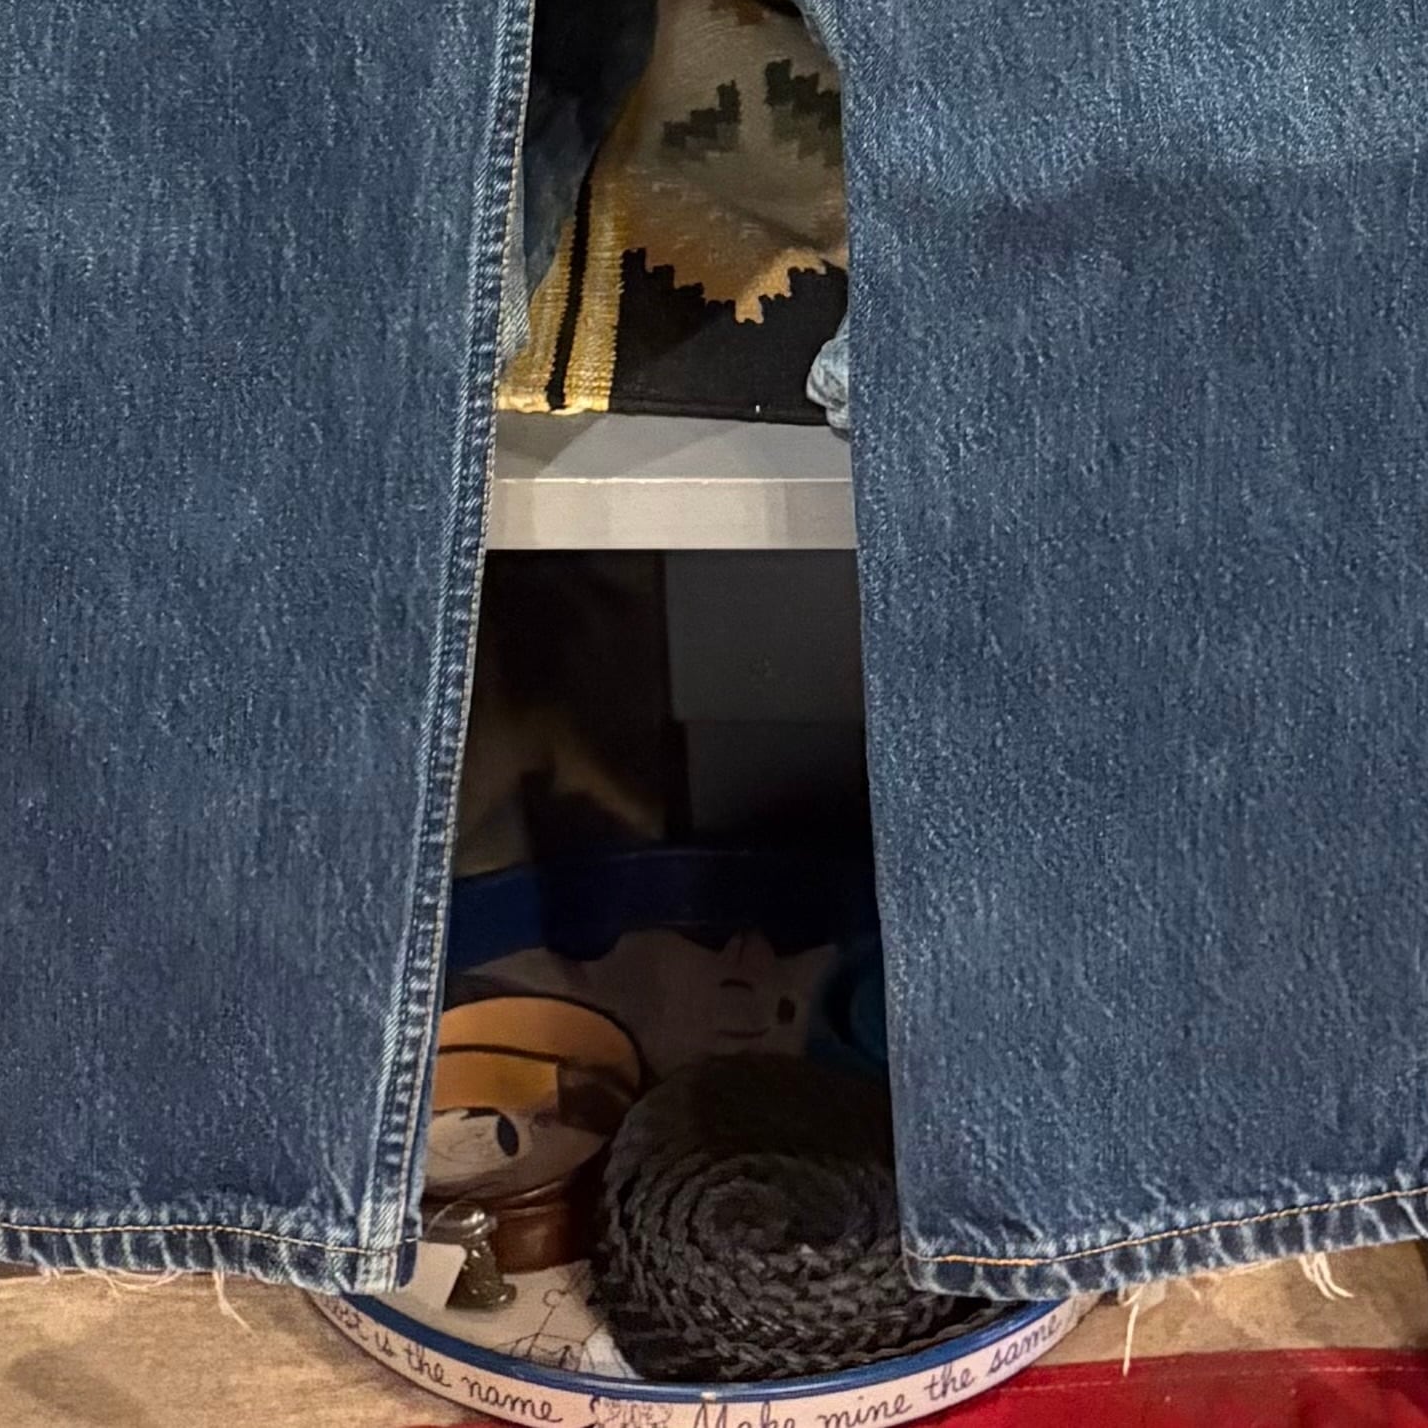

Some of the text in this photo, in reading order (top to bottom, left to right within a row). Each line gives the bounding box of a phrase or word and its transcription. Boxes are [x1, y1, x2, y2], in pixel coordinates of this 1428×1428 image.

[403, 1344, 452, 1388] the
[460, 1375, 564, 1424] name
[817, 1394, 913, 1428] mine
[924, 1361, 976, 1402] the
[987, 1313, 1063, 1376] same
